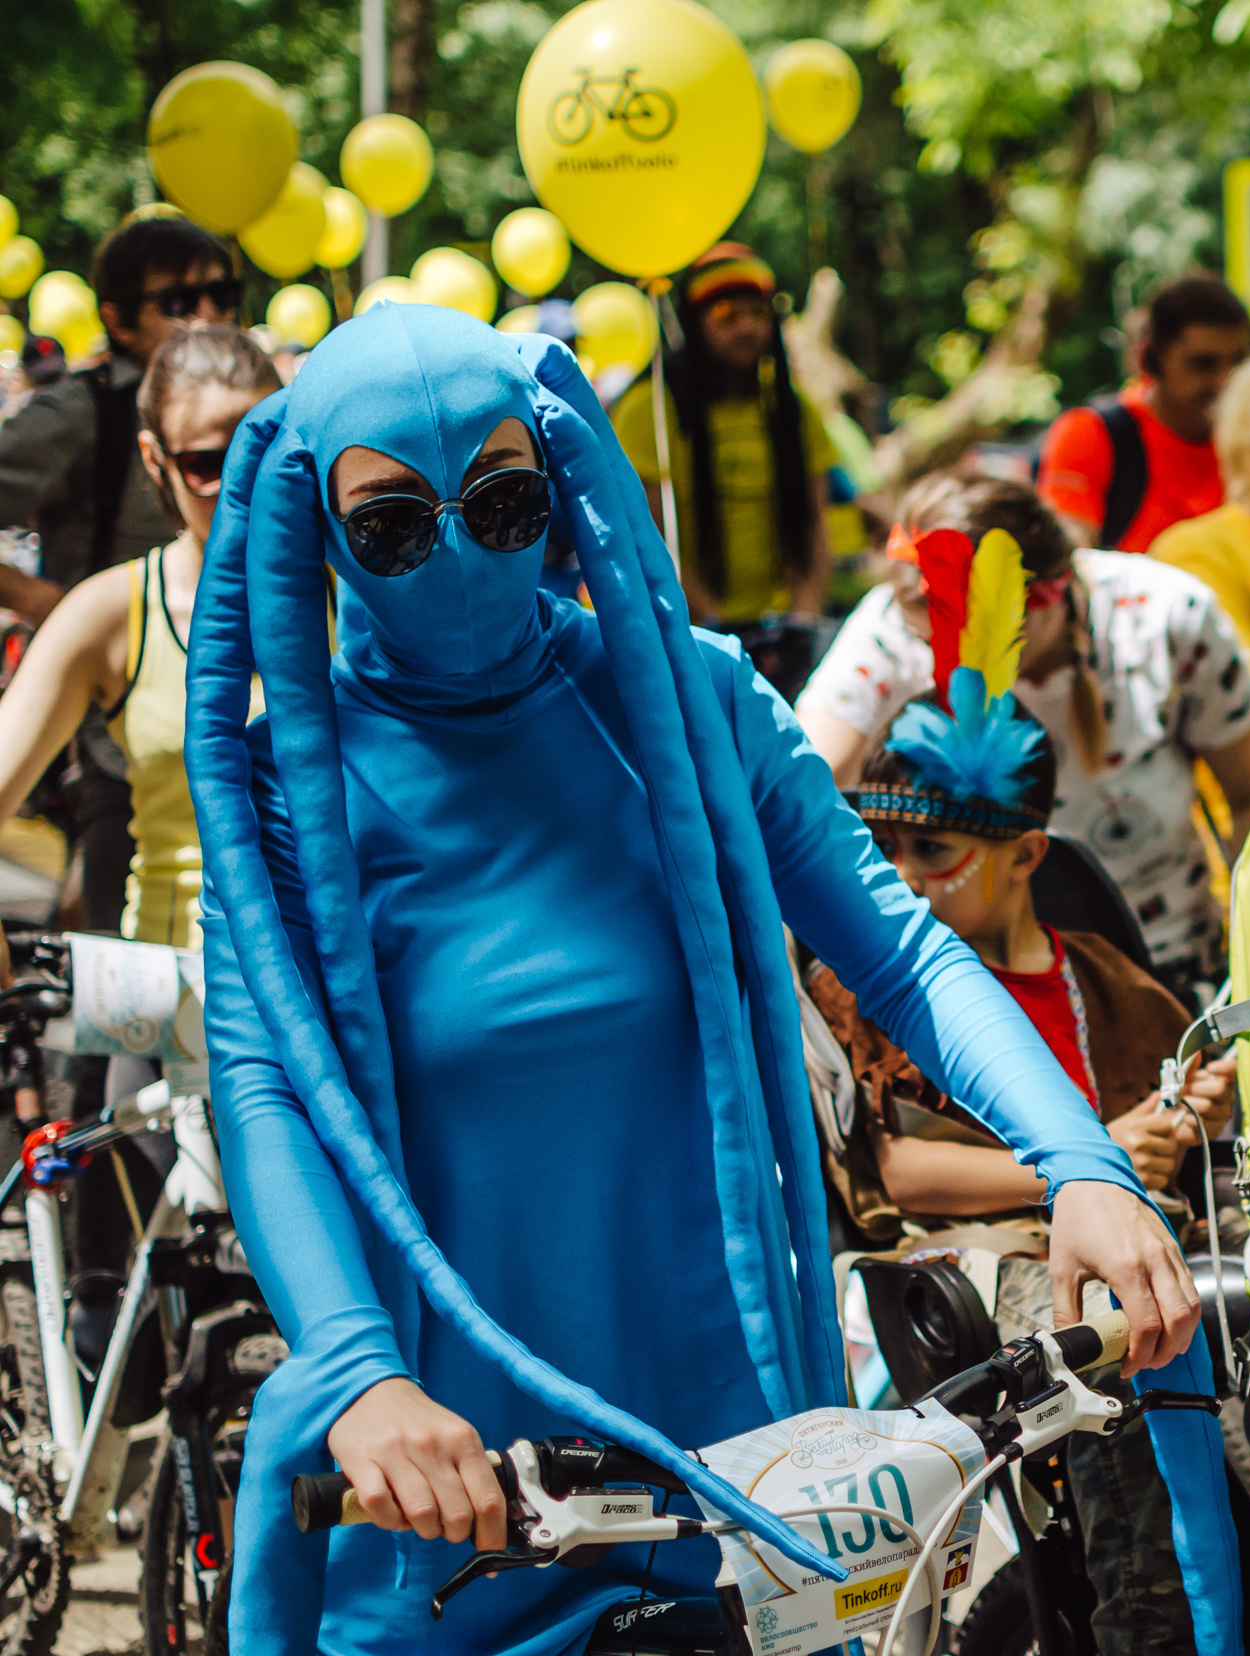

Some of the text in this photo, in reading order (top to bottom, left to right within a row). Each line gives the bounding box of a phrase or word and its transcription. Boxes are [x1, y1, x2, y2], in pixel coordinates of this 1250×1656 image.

[560, 1448, 600, 1458] DEORE
[798, 1463, 914, 1559] 130
[842, 1581, 903, 1610] Tinkoff.ru
[760, 1621, 819, 1644] ВЕЛОСООБЩЕСТВО
